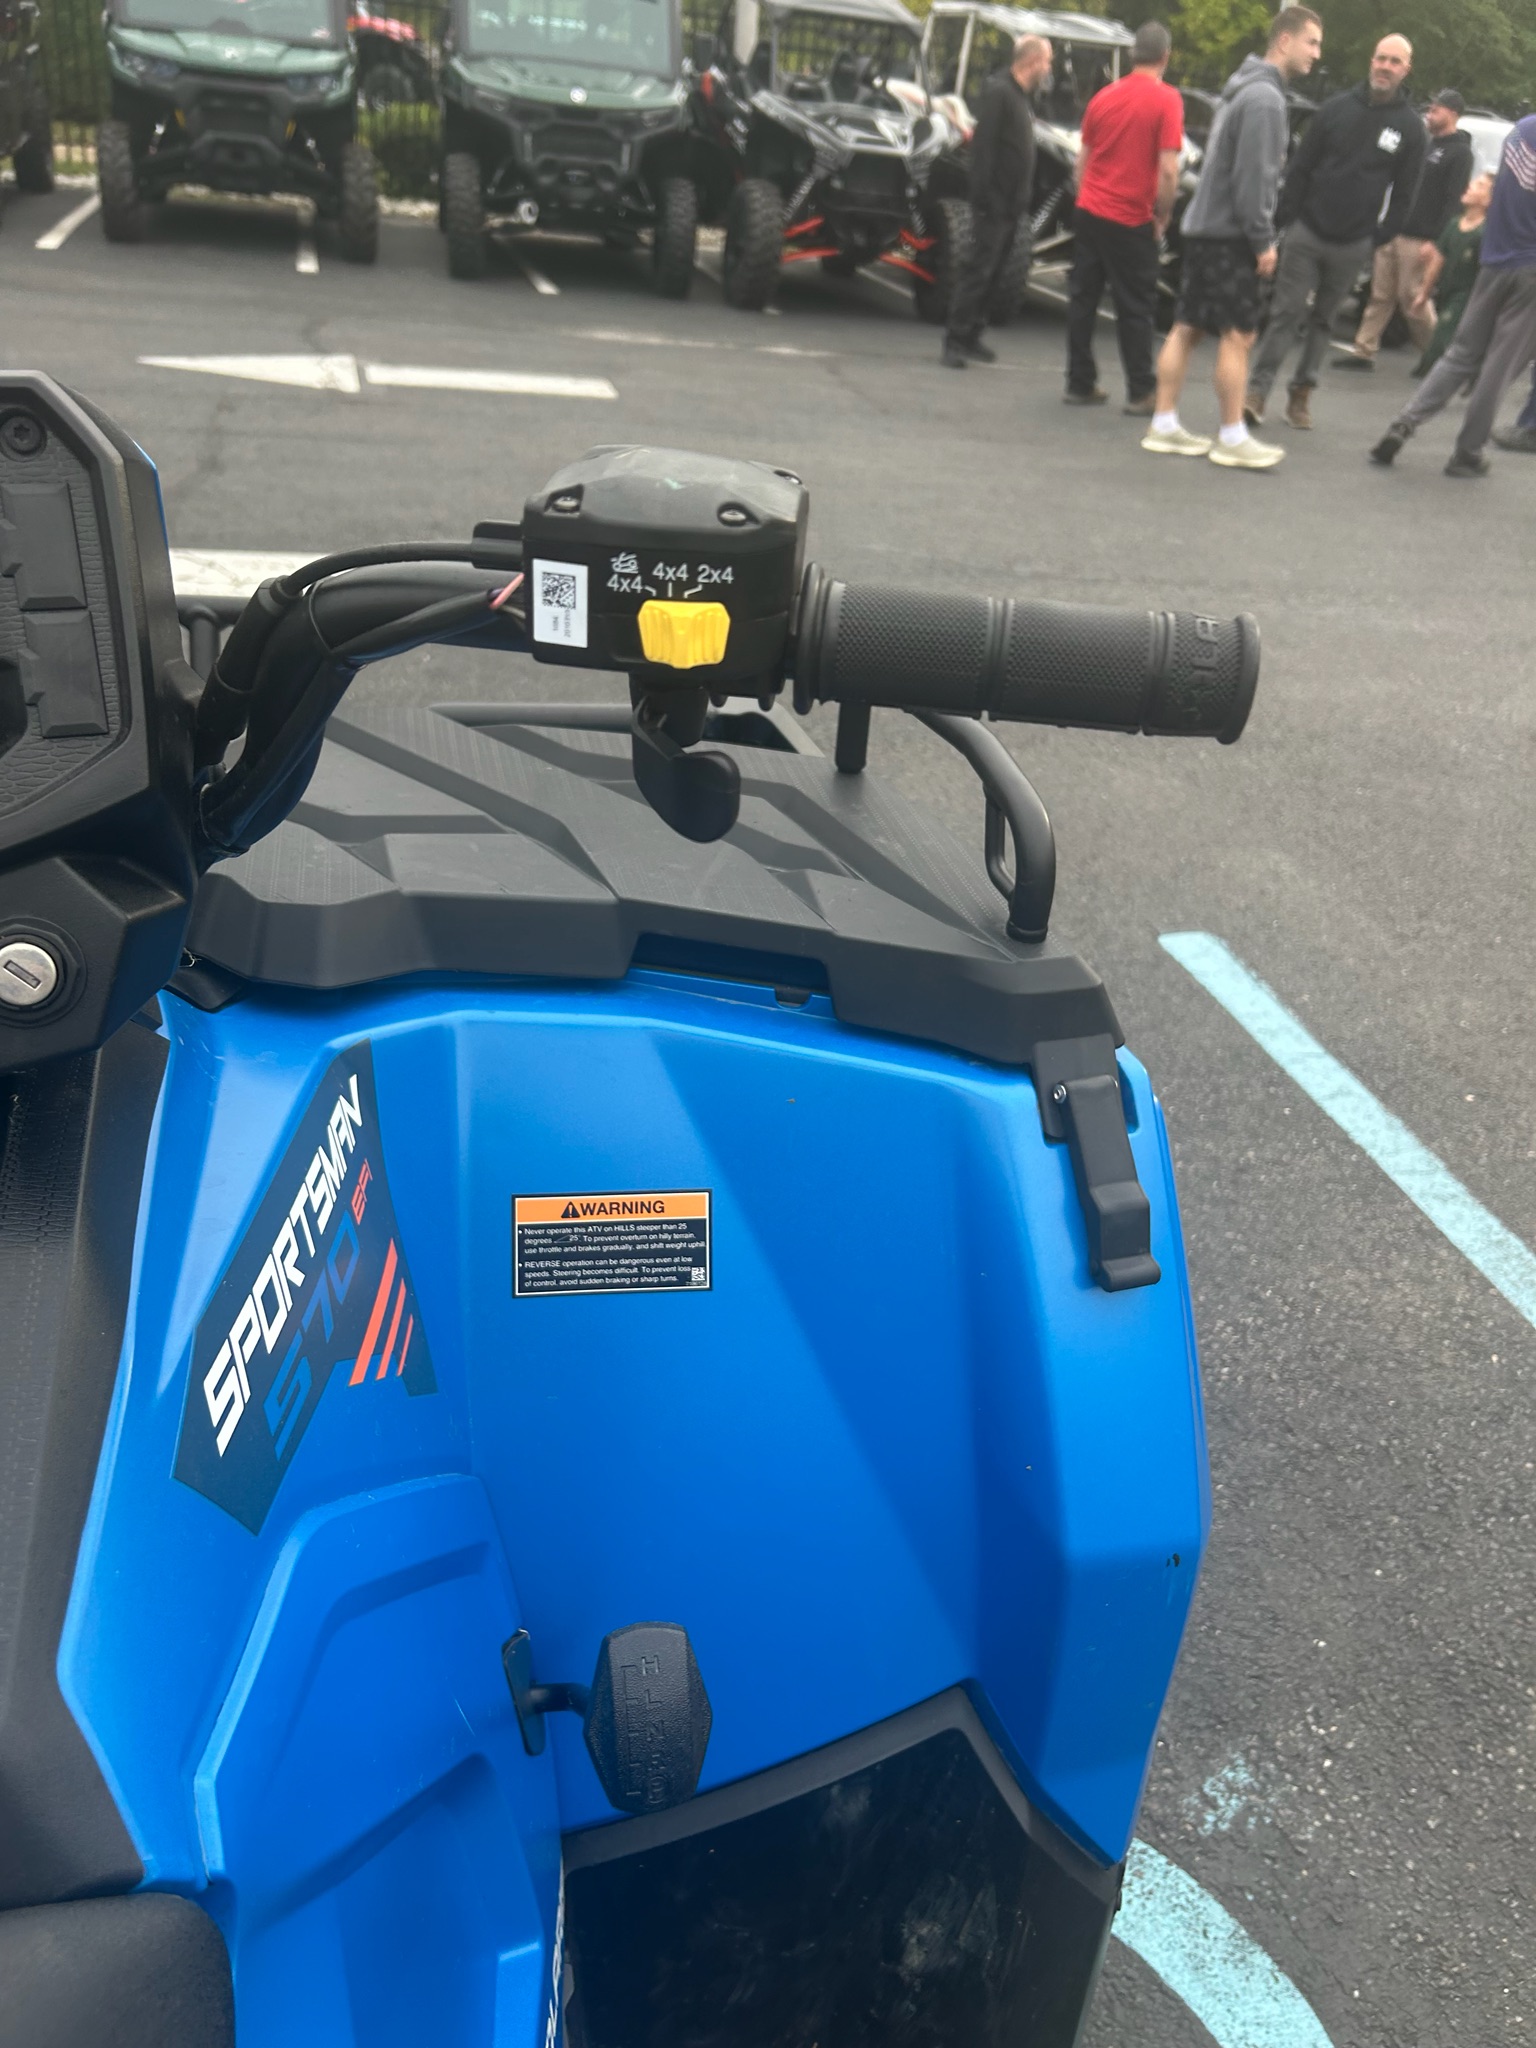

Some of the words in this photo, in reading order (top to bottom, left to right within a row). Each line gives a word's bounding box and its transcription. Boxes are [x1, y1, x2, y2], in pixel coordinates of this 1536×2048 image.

[652, 562, 689, 581] 4x4
[697, 564, 734, 584] 2x4
[607, 574, 643, 592] 4x4
[580, 1200, 665, 1216] WARNING
[636, 1224, 661, 1232] steeper
[524, 1237, 552, 1246] degrees
[593, 1235, 619, 1243] prevent
[665, 1241, 687, 1250] weight
[203, 1074, 363, 1457] SPORTSMAN
[524, 1260, 560, 1268] REVERSE
[562, 1260, 594, 1268] operation
[620, 1257, 654, 1265] dangerous
[552, 1269, 581, 1277] Steering
[605, 1277, 630, 1285] braking
[263, 1210, 361, 1461] 570
[351, 1158, 373, 1225] EFI
[641, 1655, 659, 1676] H
[645, 1689, 663, 1709] L
